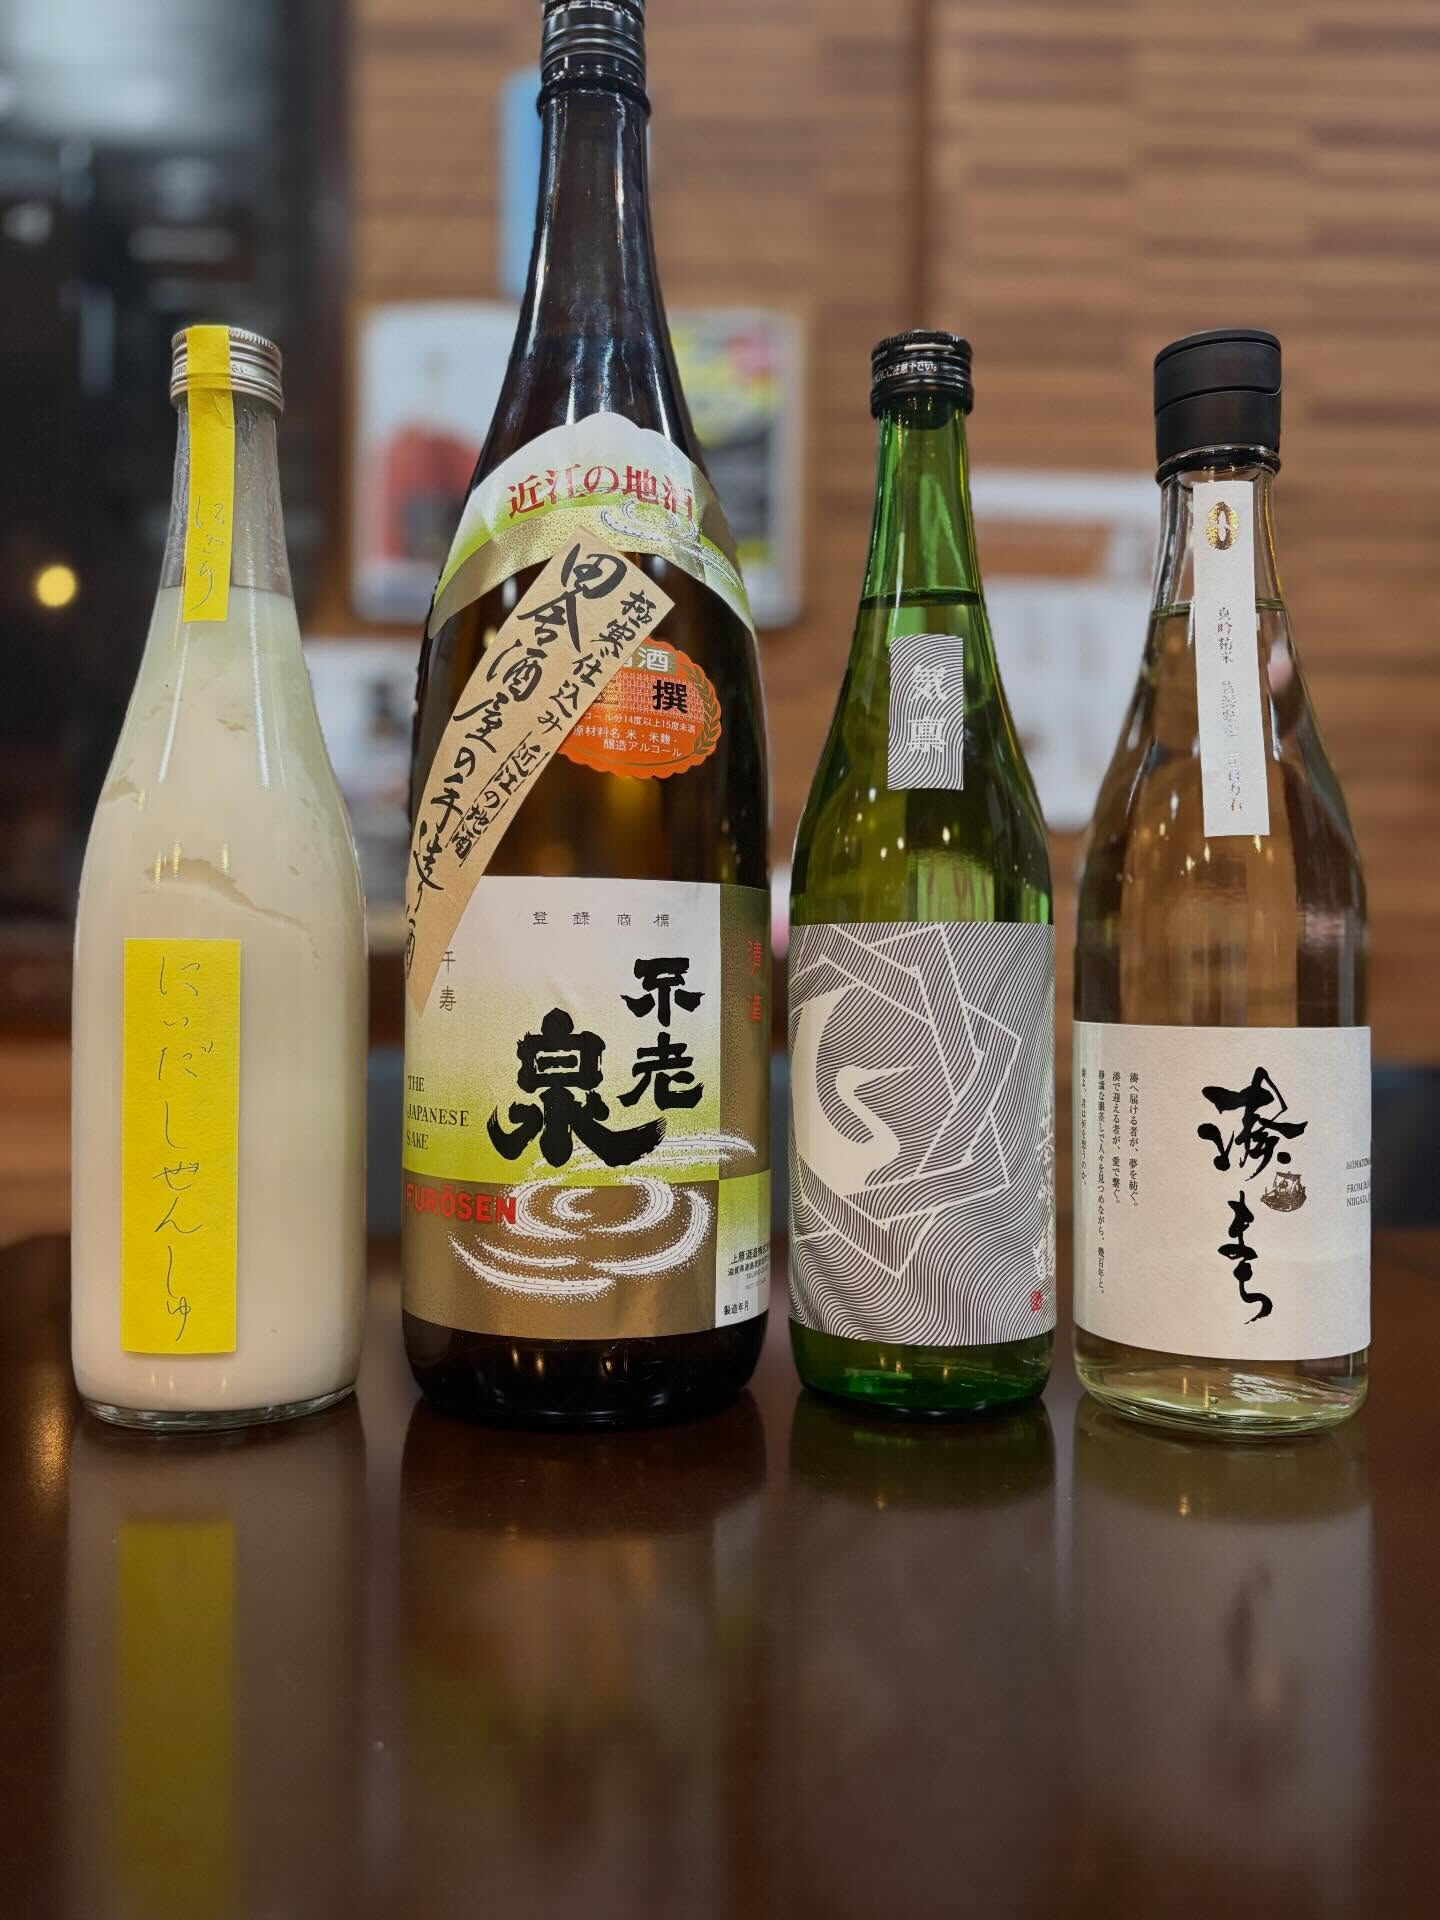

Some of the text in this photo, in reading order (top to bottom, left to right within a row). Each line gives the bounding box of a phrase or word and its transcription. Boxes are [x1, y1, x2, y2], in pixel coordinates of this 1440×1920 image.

[508, 463, 694, 520] 近江の地酒
[532, 911, 671, 928] 登録商標
[439, 951, 457, 1012] 千寿
[408, 1076, 425, 1092] THE
[407, 1104, 470, 1127] JAPANESE
[406, 1131, 429, 1150] SAKE
